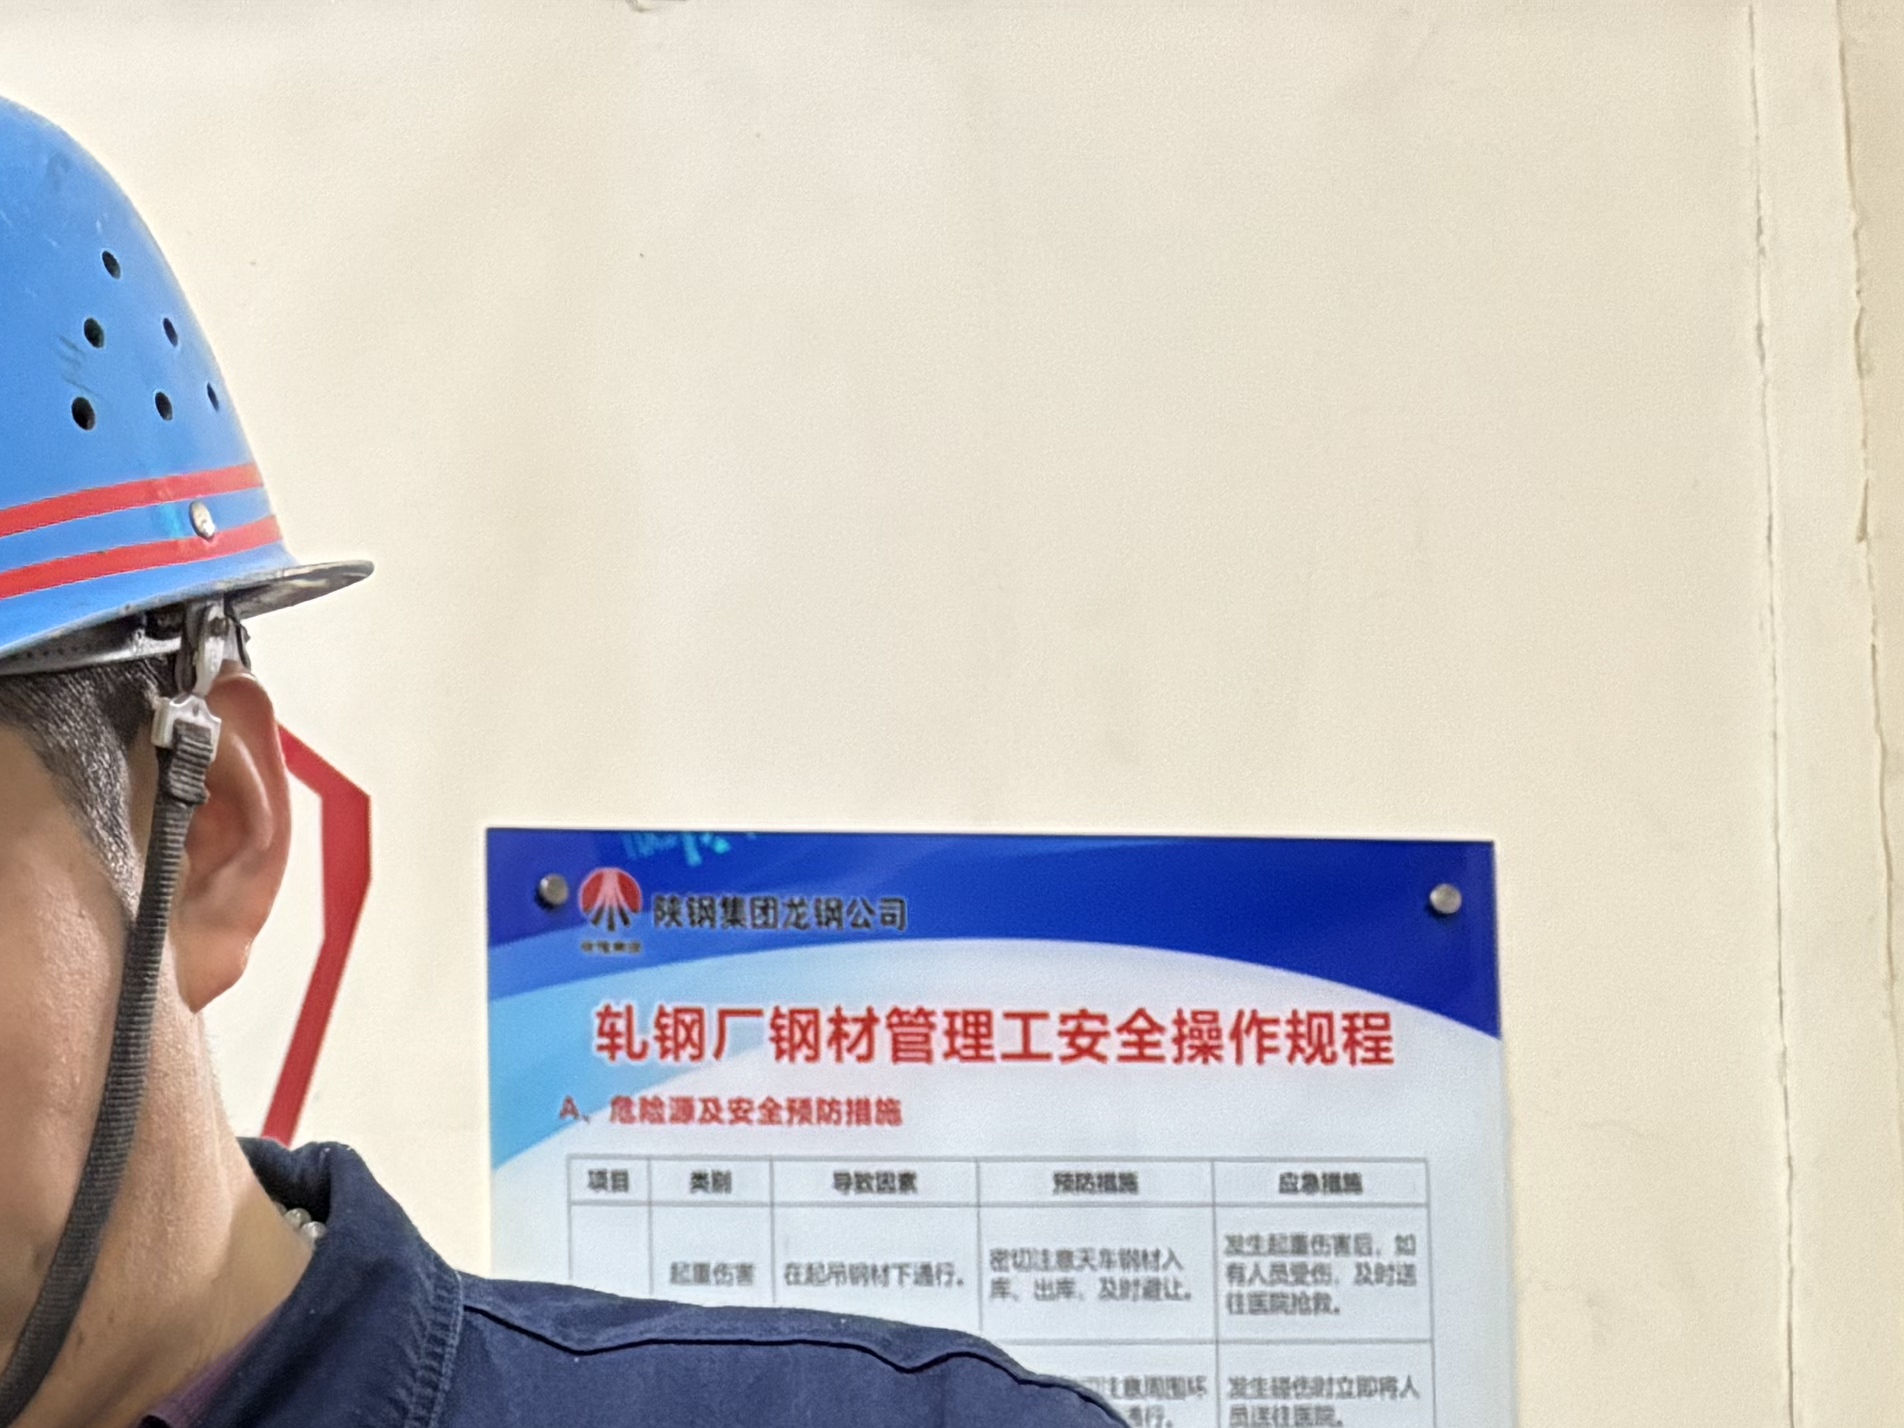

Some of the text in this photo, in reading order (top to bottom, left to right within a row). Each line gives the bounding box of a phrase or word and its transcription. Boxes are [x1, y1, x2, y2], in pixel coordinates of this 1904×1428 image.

[653, 894, 907, 930] 陕钢集团龙钢公司
[594, 1004, 1395, 1069] 轧钢厂钢材管理工安全操作规程
